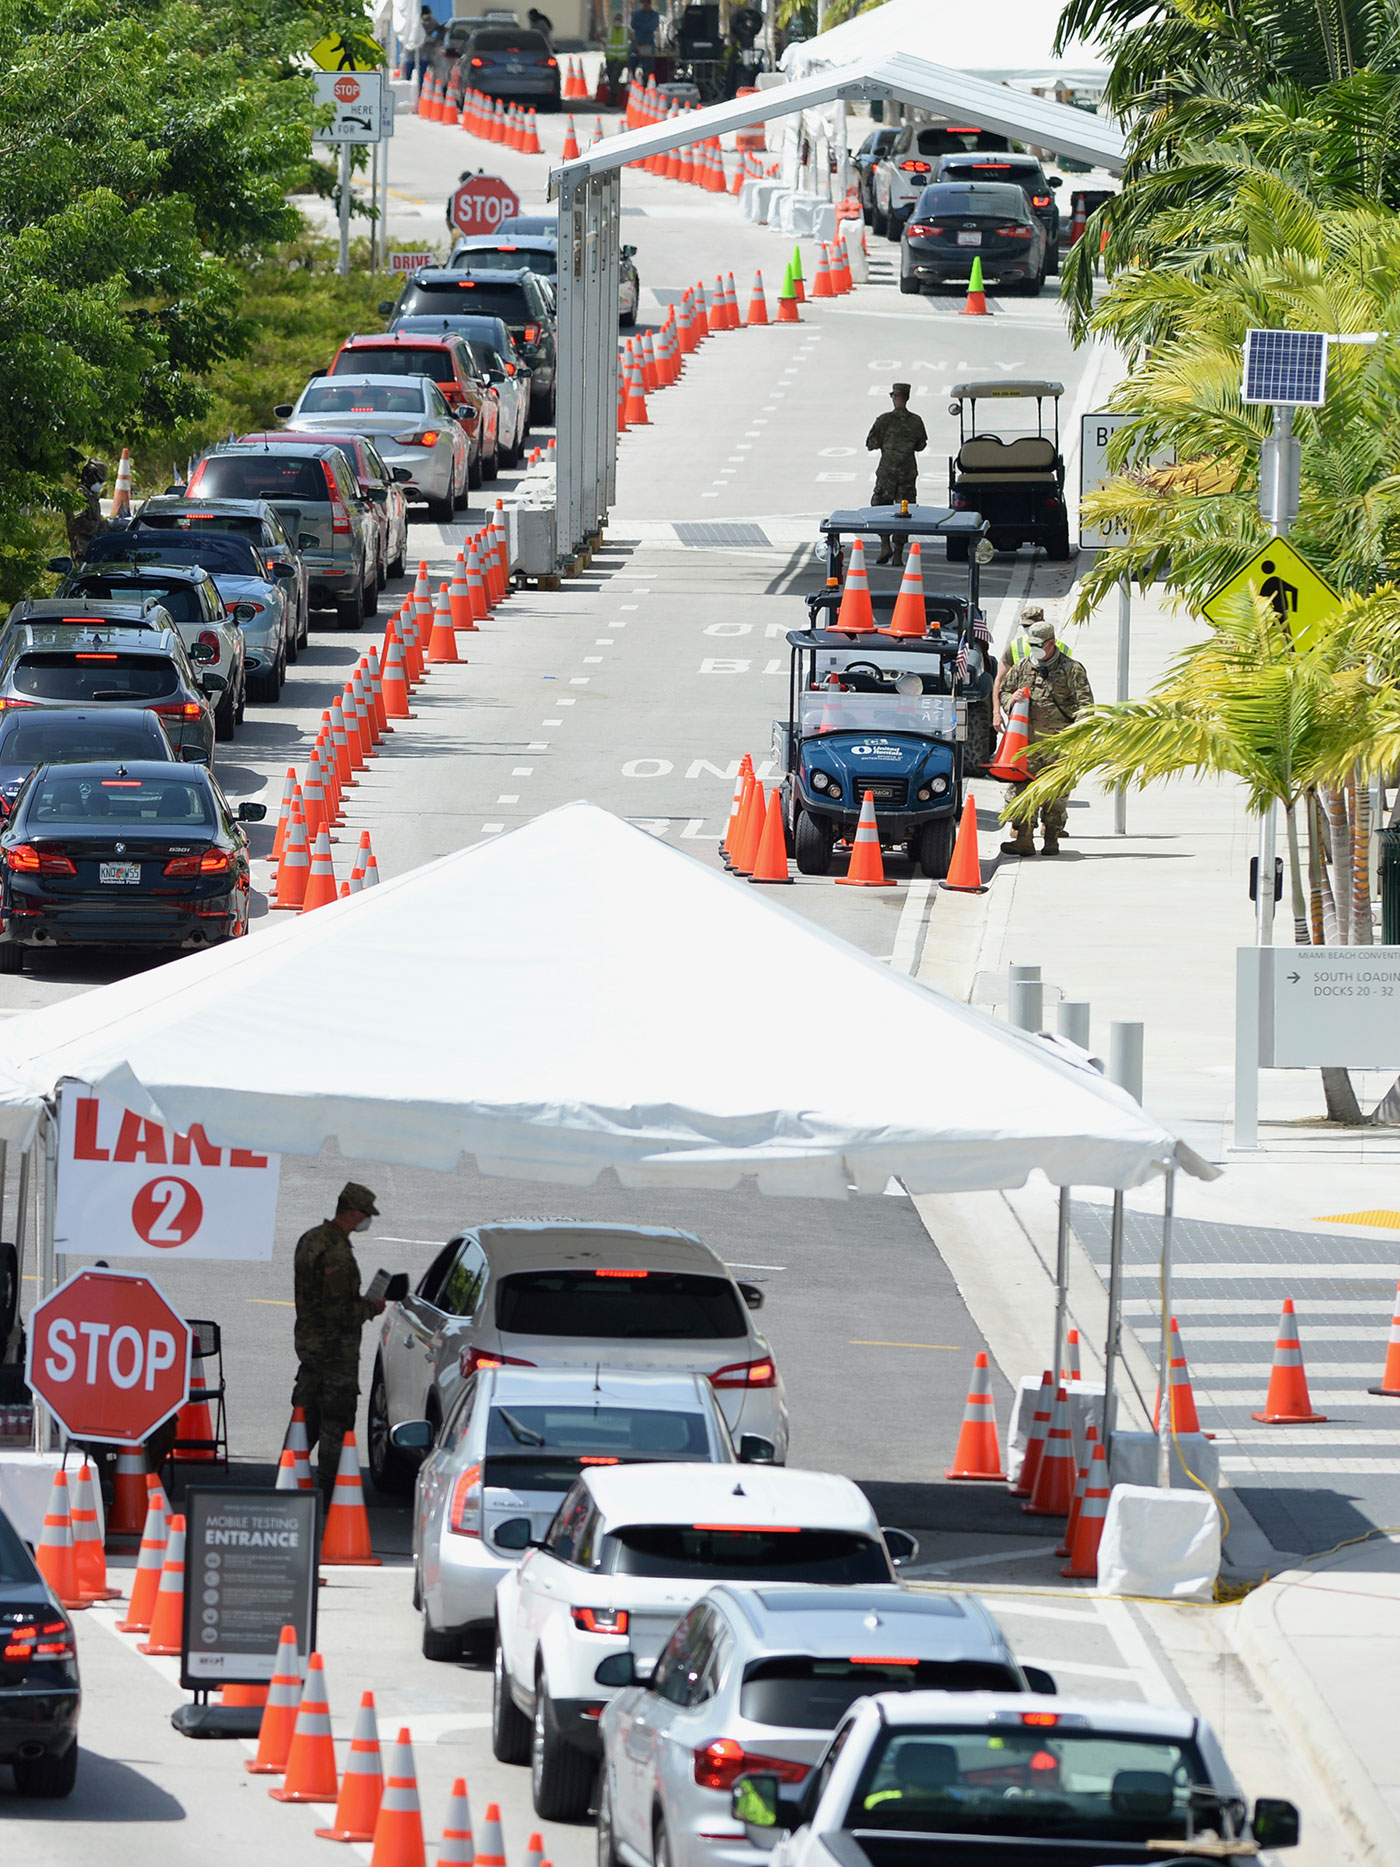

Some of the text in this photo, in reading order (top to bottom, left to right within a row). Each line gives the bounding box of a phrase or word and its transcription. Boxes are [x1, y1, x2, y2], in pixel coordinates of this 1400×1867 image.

[335, 85, 359, 95] STOP
[351, 105, 373, 114] HERE
[338, 125, 355, 133] FOR
[458, 194, 514, 223] STOP
[393, 255, 430, 269] DRIVE
[867, 360, 1024, 371] ONLY
[1314, 972, 1353, 981] SOUTH
[1314, 986, 1353, 996] DOCKS
[1357, 986, 1370, 995] 20
[1381, 986, 1393, 996] 32
[148, 1180, 187, 1241] 2
[45, 1318, 176, 1391] STOP
[206, 1516, 299, 1529] MOBILE TESTING
[205, 1530, 299, 1547] ENTRANCE
